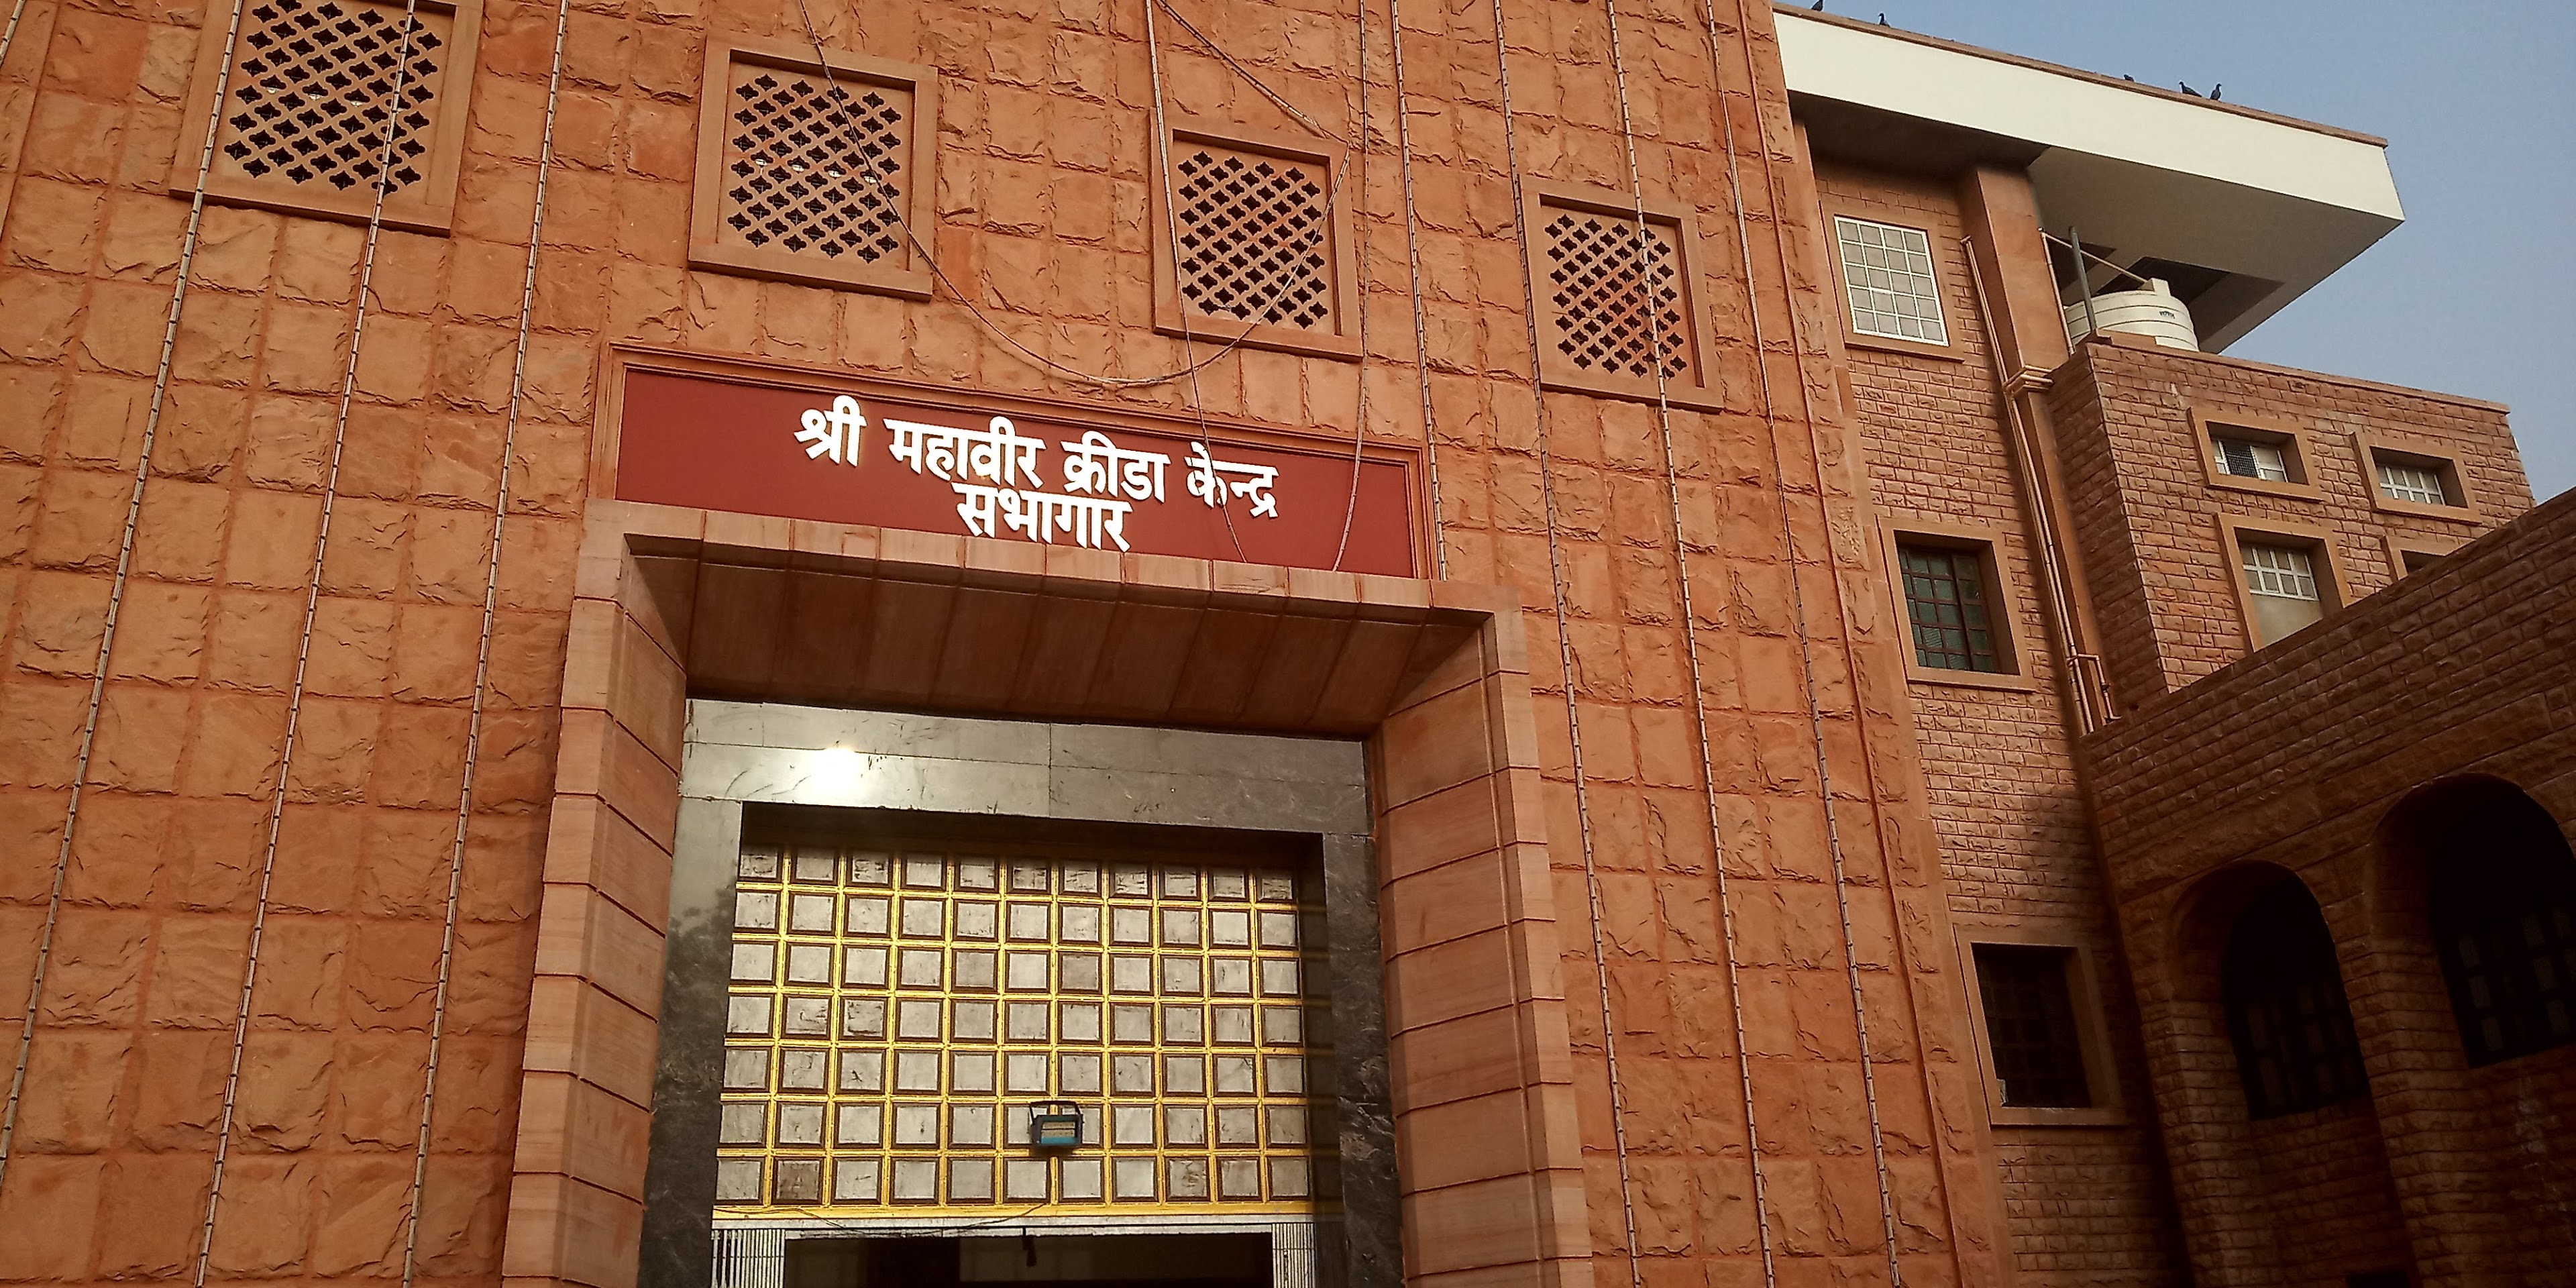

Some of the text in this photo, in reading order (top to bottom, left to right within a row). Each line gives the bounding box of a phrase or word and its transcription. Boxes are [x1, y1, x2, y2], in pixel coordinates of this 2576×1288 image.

[794, 394, 1279, 518] श्री महावीर क्रीडा केन्द्र
[951, 482, 1133, 553] सभागार
